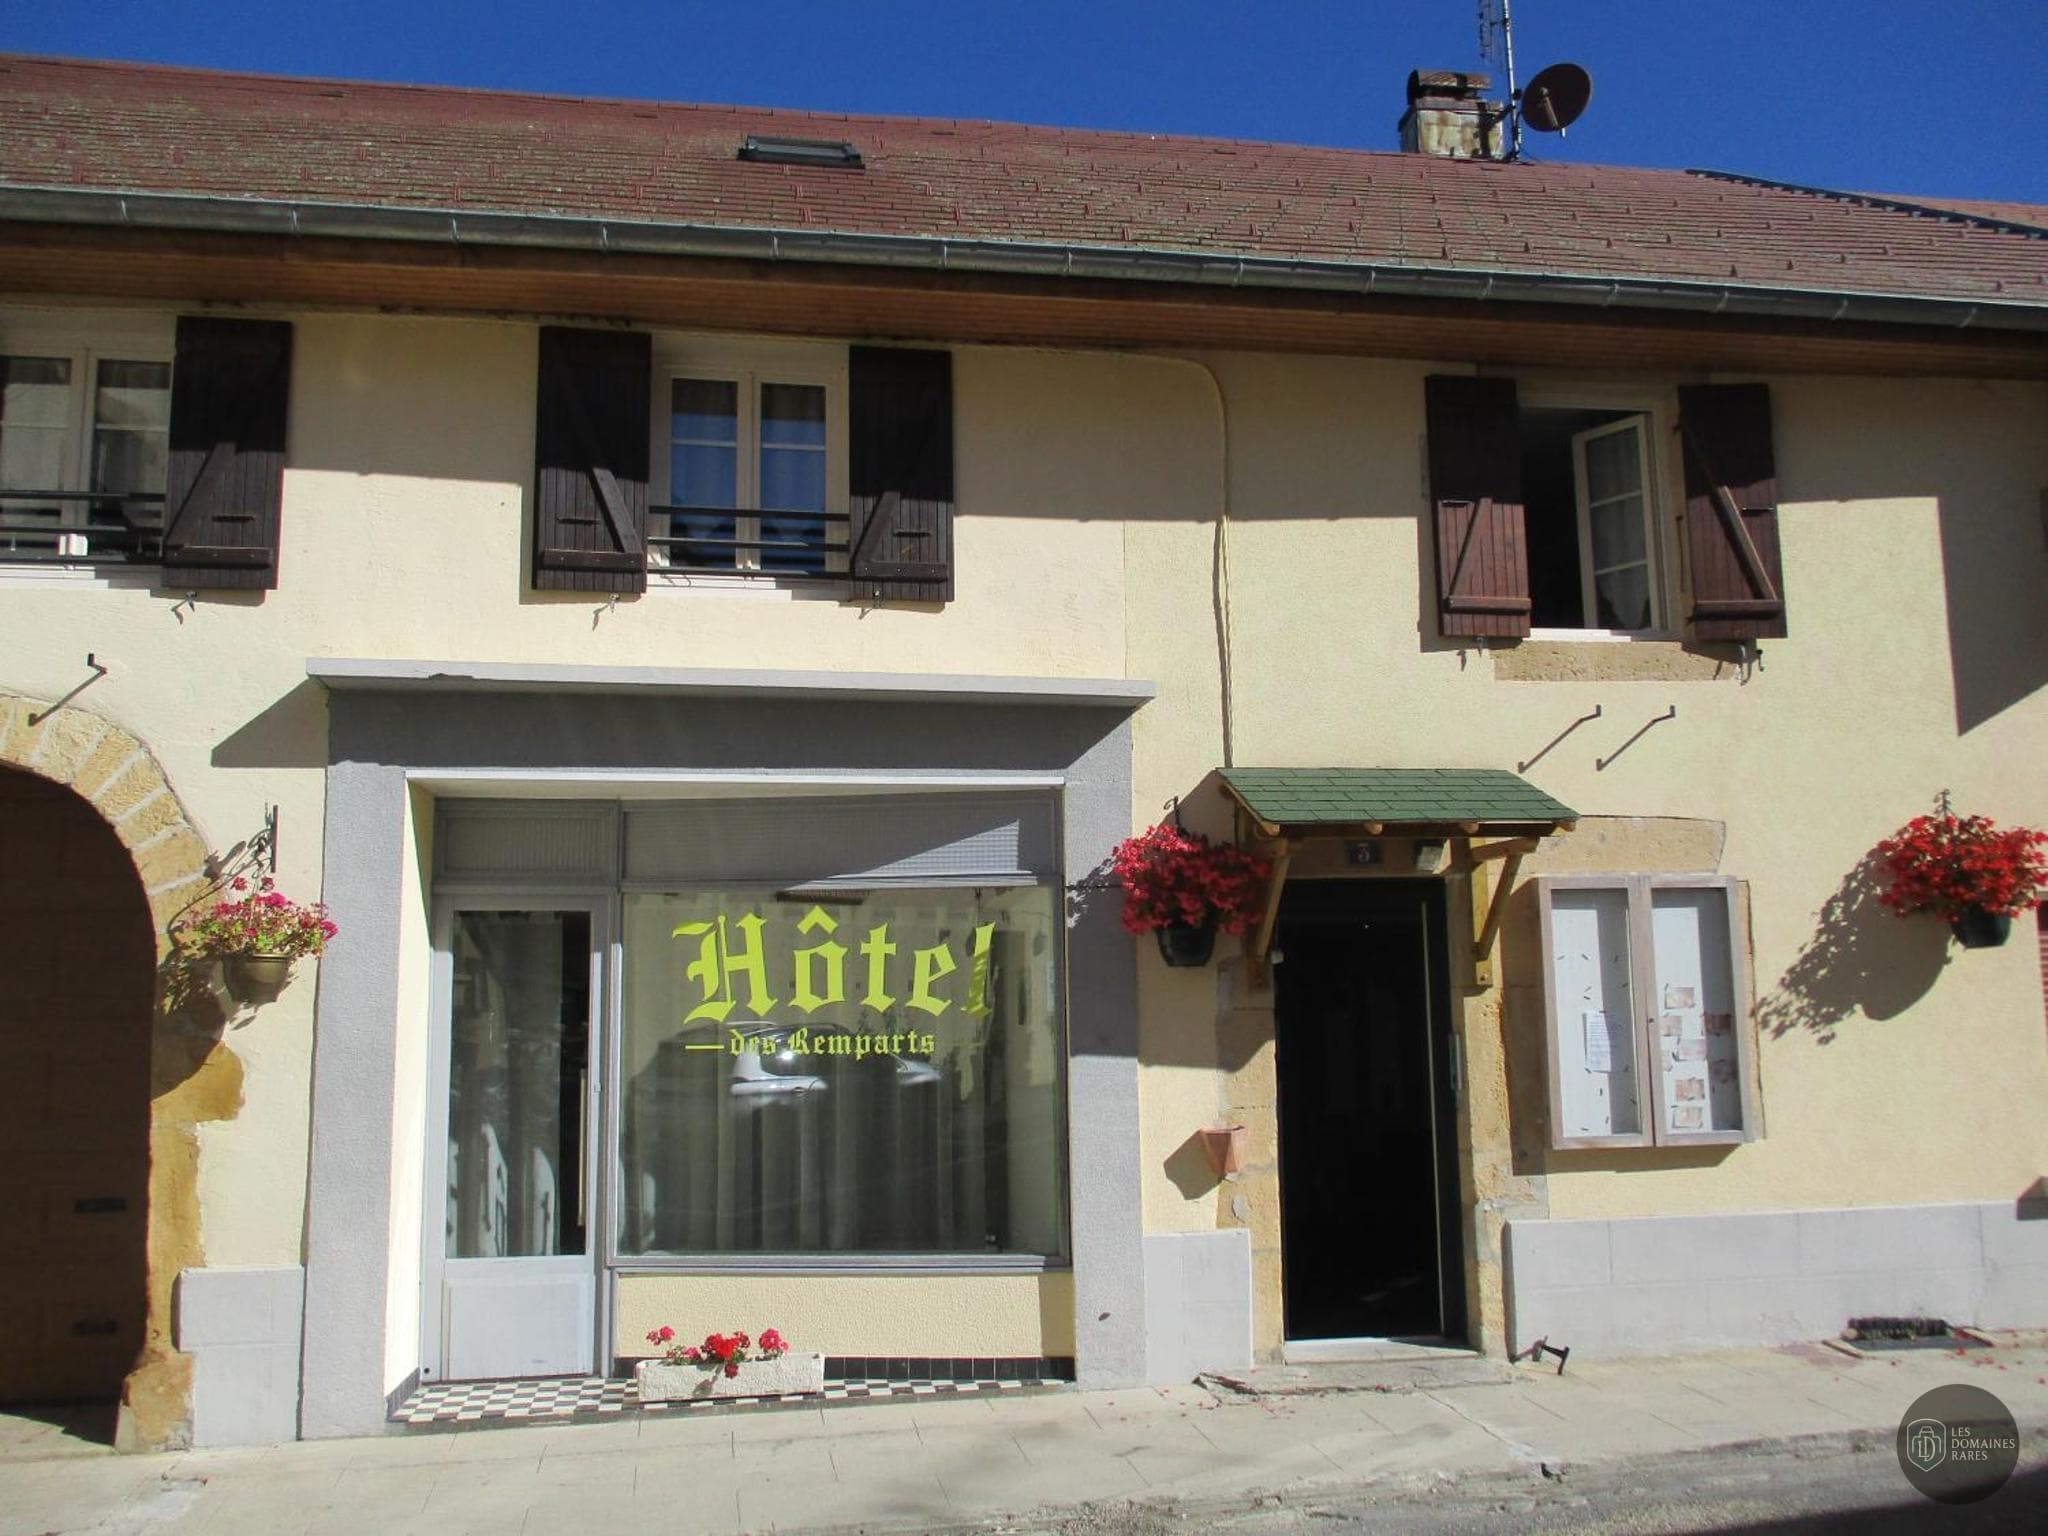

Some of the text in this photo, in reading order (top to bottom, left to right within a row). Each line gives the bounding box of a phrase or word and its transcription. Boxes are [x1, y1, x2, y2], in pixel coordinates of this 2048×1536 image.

[672, 905, 995, 1025] Hôtel
[729, 1027, 936, 1062] des Remparts
